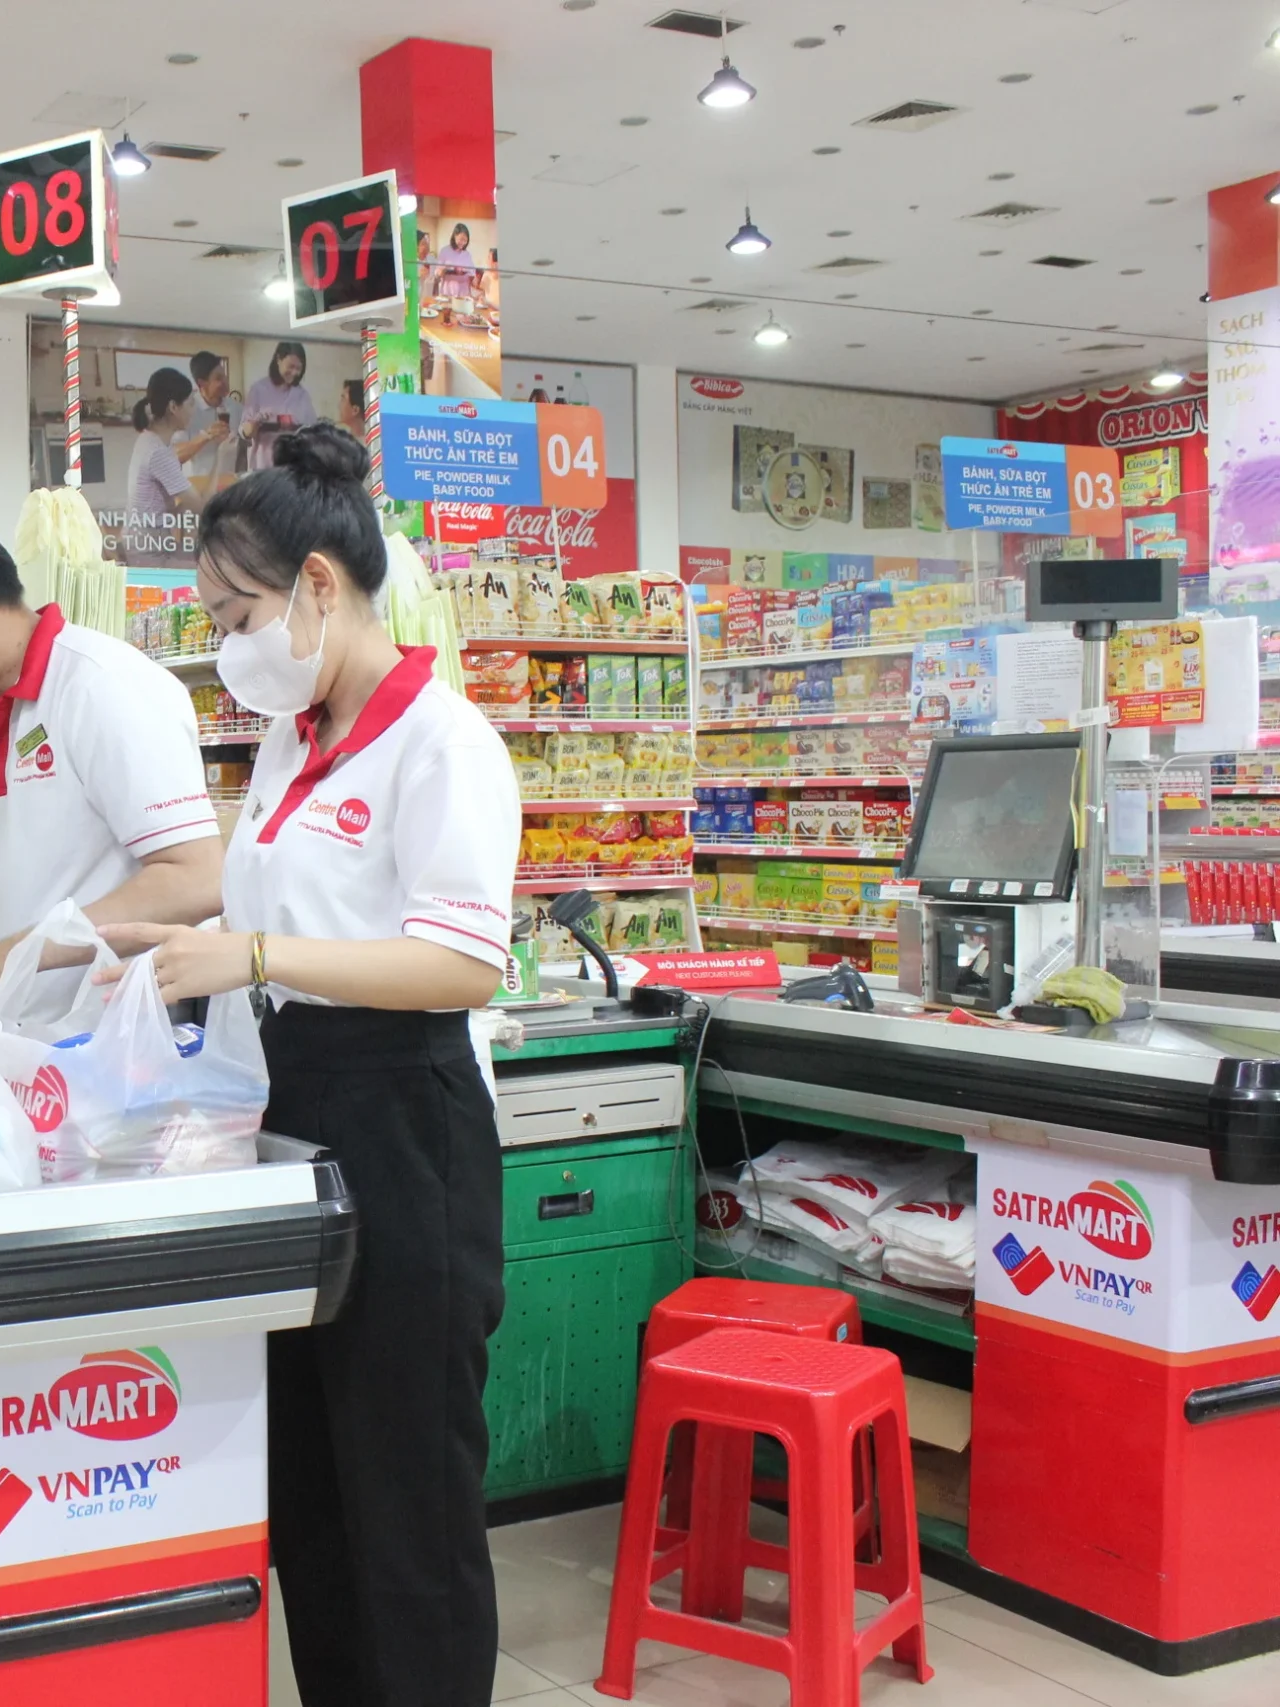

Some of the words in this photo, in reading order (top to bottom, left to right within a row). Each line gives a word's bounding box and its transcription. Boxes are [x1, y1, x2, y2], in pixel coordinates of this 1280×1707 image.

[1, 170, 85, 256] 08
[300, 207, 384, 292] 07
[1100, 401, 1196, 443] ORION
[407, 425, 451, 446] BÁNH,
[454, 428, 483, 447] SỮA
[485, 431, 513, 450] BỘT
[404, 443, 444, 461] THỨC
[446, 444, 467, 463] ĂN
[469, 448, 496, 465] TRẺ
[499, 453, 518, 466] EM
[547, 433, 599, 478] 04
[1126, 455, 1159, 470] Custas
[414, 470, 434, 484] PIE,
[436, 471, 483, 485] POWDER
[485, 473, 511, 486] MILK
[962, 465, 997, 481] BÁNH,
[999, 467, 1022, 482] SỮA
[1024, 470, 1048, 486] BỘT
[433, 484, 462, 497] BABY
[464, 485, 494, 498] FOOD
[960, 480, 991, 496] THỨC
[993, 481, 1010, 497] ĂN
[1011, 483, 1034, 498] TRẺ
[1036, 487, 1052, 499] EM
[1073, 471, 1115, 510] 03
[99, 508, 157, 533] NHẬN
[968, 503, 984, 515] PIE,
[986, 504, 1023, 516] POWDER
[1025, 506, 1046, 517] MILK
[983, 515, 1006, 526] BABY
[1007, 516, 1033, 527] FOOD
[123, 531, 177, 551] TỪNG
[480, 571, 509, 599] An
[607, 584, 635, 610] An
[1183, 663, 1199, 673] LIX
[37, 751, 52, 764] Mall
[164, 798, 183, 808] SATRA
[308, 799, 337, 816] Centre
[338, 806, 368, 827] Mall
[456, 900, 483, 912] SATRA
[657, 959, 676, 970] MỜI
[676, 957, 708, 969] KHÁCH
[709, 956, 735, 969] HÀNG
[736, 955, 748, 967] KẾ
[749, 954, 765, 967] TIẾP
[506, 957, 517, 991] MILO
[675, 971, 691, 980] NEXT
[692, 970, 728, 979] CUSTOMER
[992, 1187, 1145, 1247] SATRAMART
[1075, 1289, 1100, 1306] Scan
[1102, 1295, 1113, 1308] to
[1116, 1299, 1136, 1316] Pay
[66, 1502, 104, 1519] Scan
[108, 1499, 124, 1513] to
[129, 1492, 158, 1510] Pay
